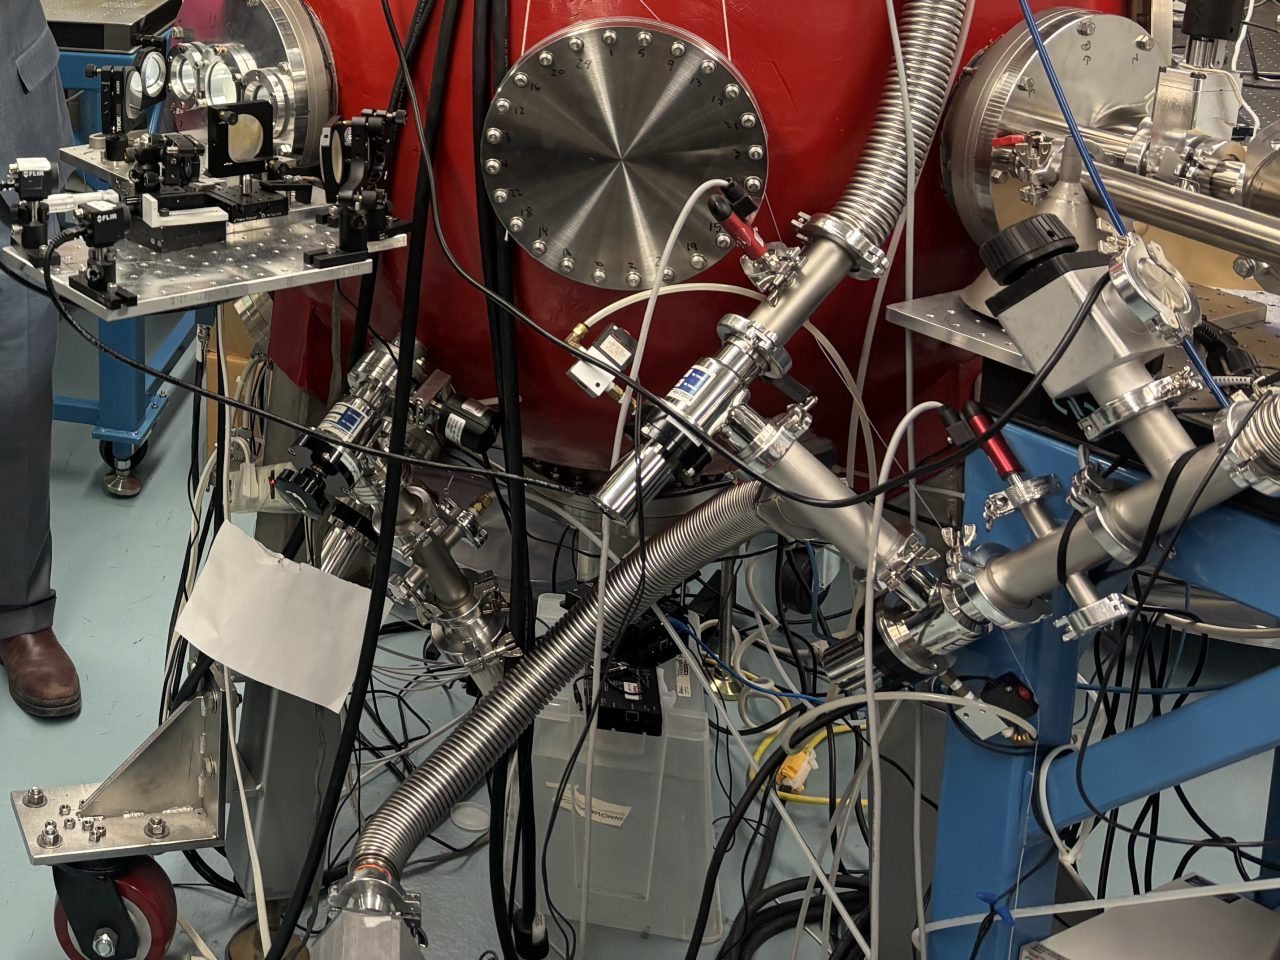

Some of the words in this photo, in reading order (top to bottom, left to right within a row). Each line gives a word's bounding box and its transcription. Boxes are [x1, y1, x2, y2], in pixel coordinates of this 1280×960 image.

[637, 48, 646, 58] 5
[576, 58, 592, 70] 24
[667, 59, 675, 72] 9
[550, 69, 566, 77] 20
[530, 82, 541, 91] 16
[689, 77, 703, 88] 13
[514, 106, 525, 115] 12
[102, 213, 118, 221] FLIR
[538, 225, 548, 238] 14
[709, 222, 722, 234] 15
[686, 242, 697, 251] 19
